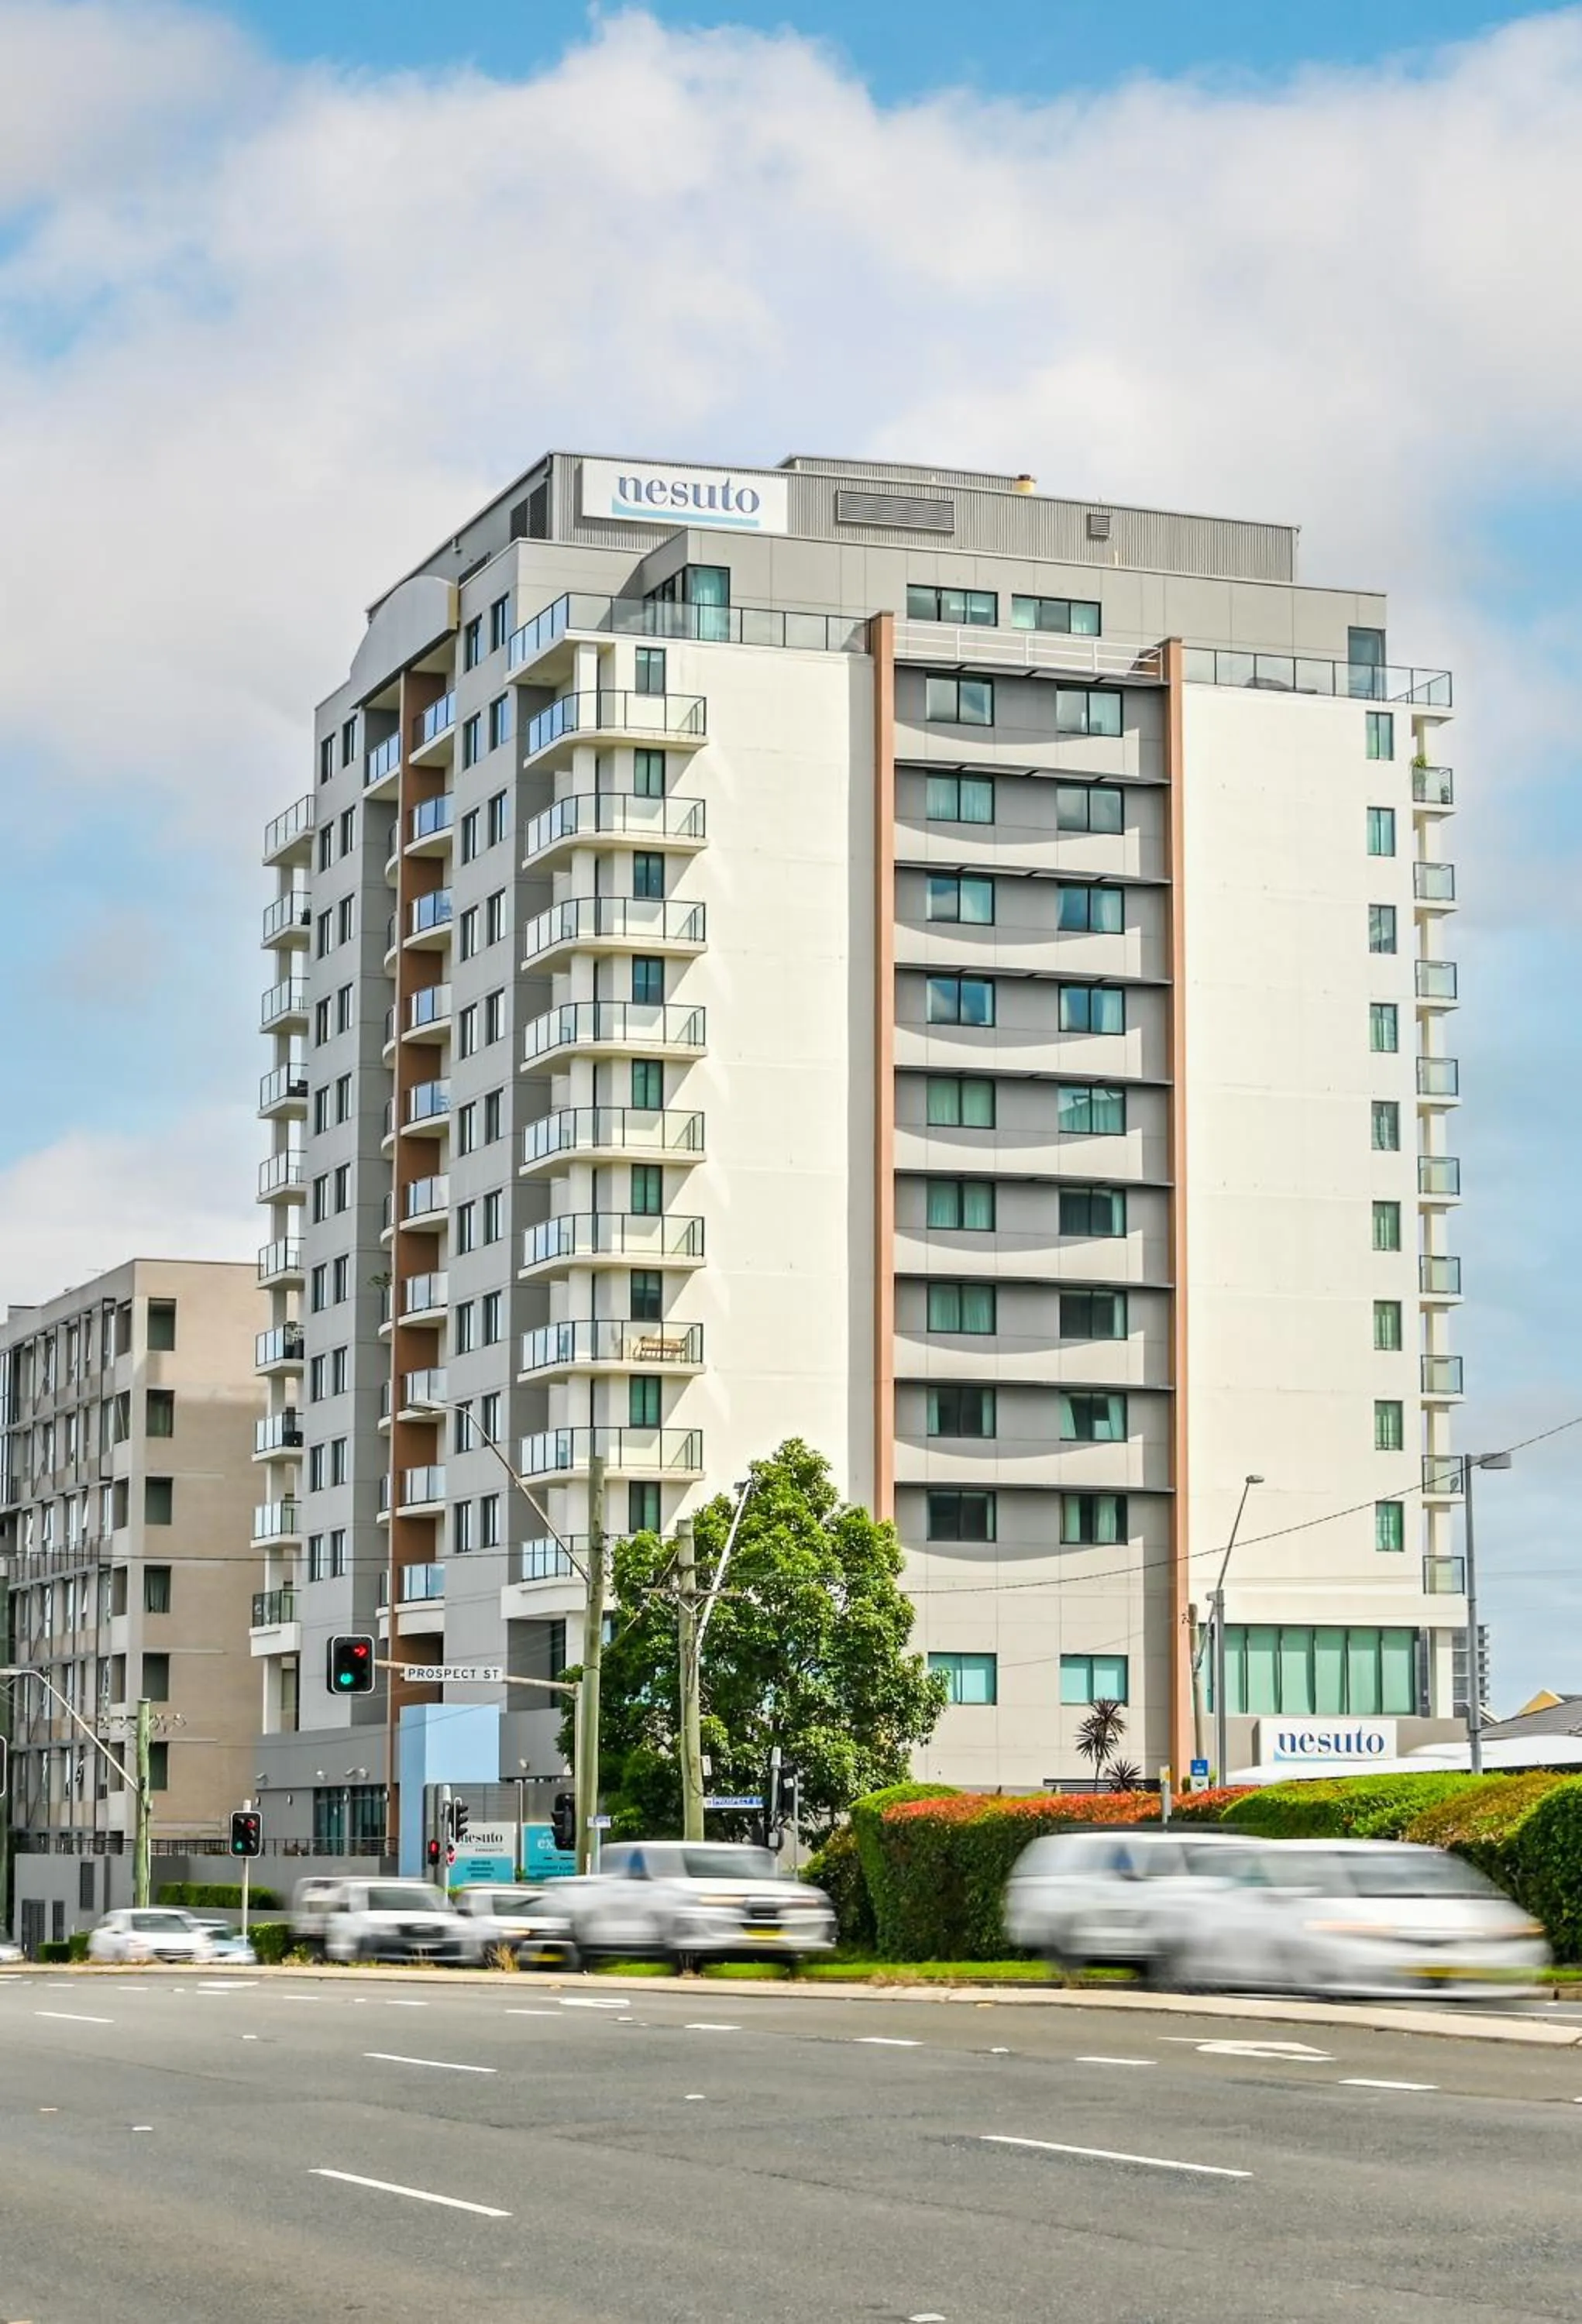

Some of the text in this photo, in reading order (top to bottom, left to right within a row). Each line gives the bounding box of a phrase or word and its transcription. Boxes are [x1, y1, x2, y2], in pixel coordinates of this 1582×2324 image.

[618, 476, 760, 514] nesuto
[408, 1667, 500, 1679] PROSPECT ST
[1278, 1725, 1385, 1755] nesuto
